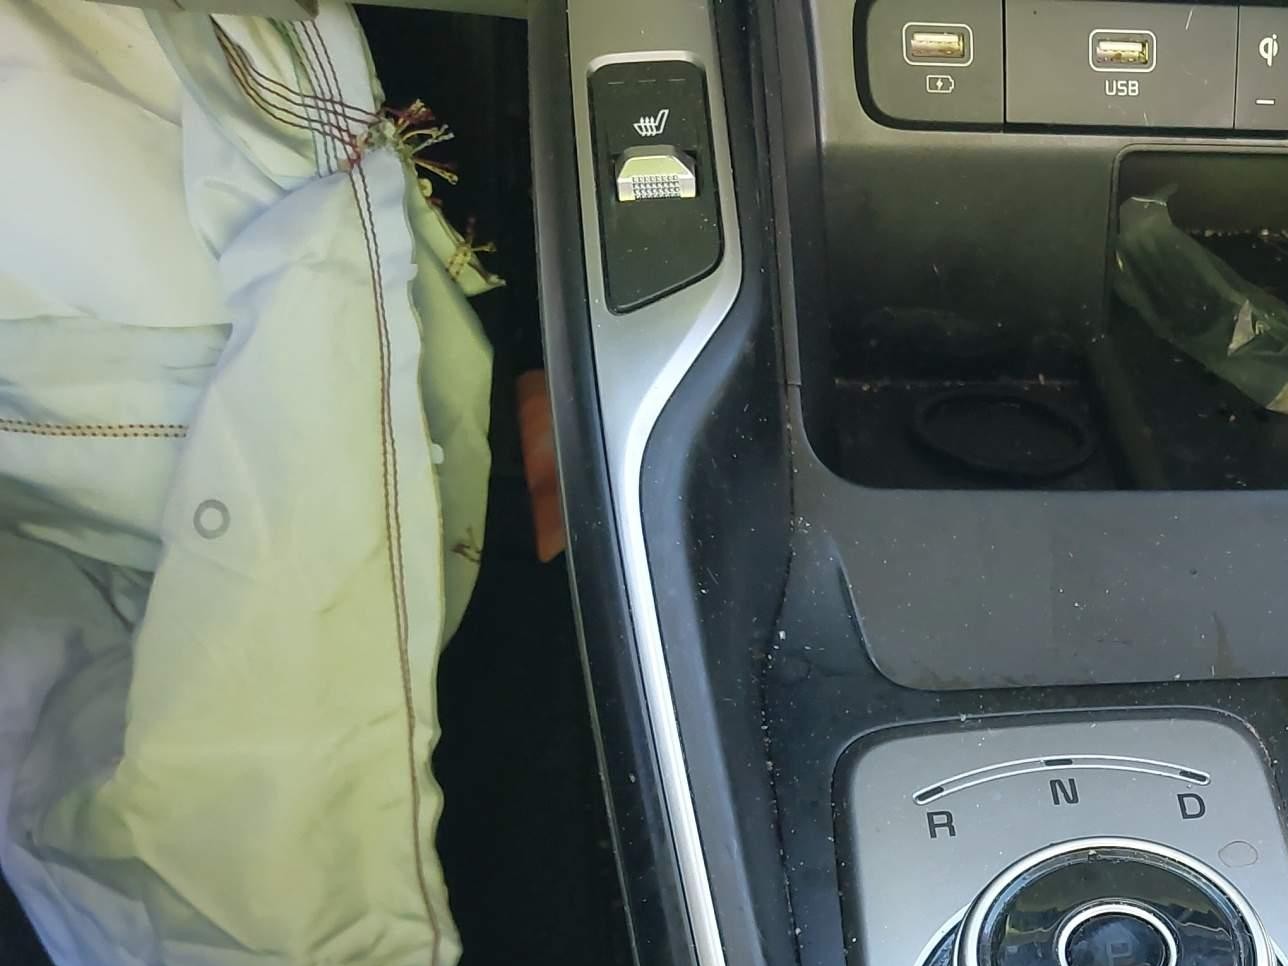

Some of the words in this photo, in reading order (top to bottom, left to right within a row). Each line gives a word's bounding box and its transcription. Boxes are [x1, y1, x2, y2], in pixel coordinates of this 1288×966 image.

[1105, 79, 1140, 97] USB
[1049, 777, 1079, 805] N
[1177, 793, 1206, 820] D
[926, 810, 957, 839] R
